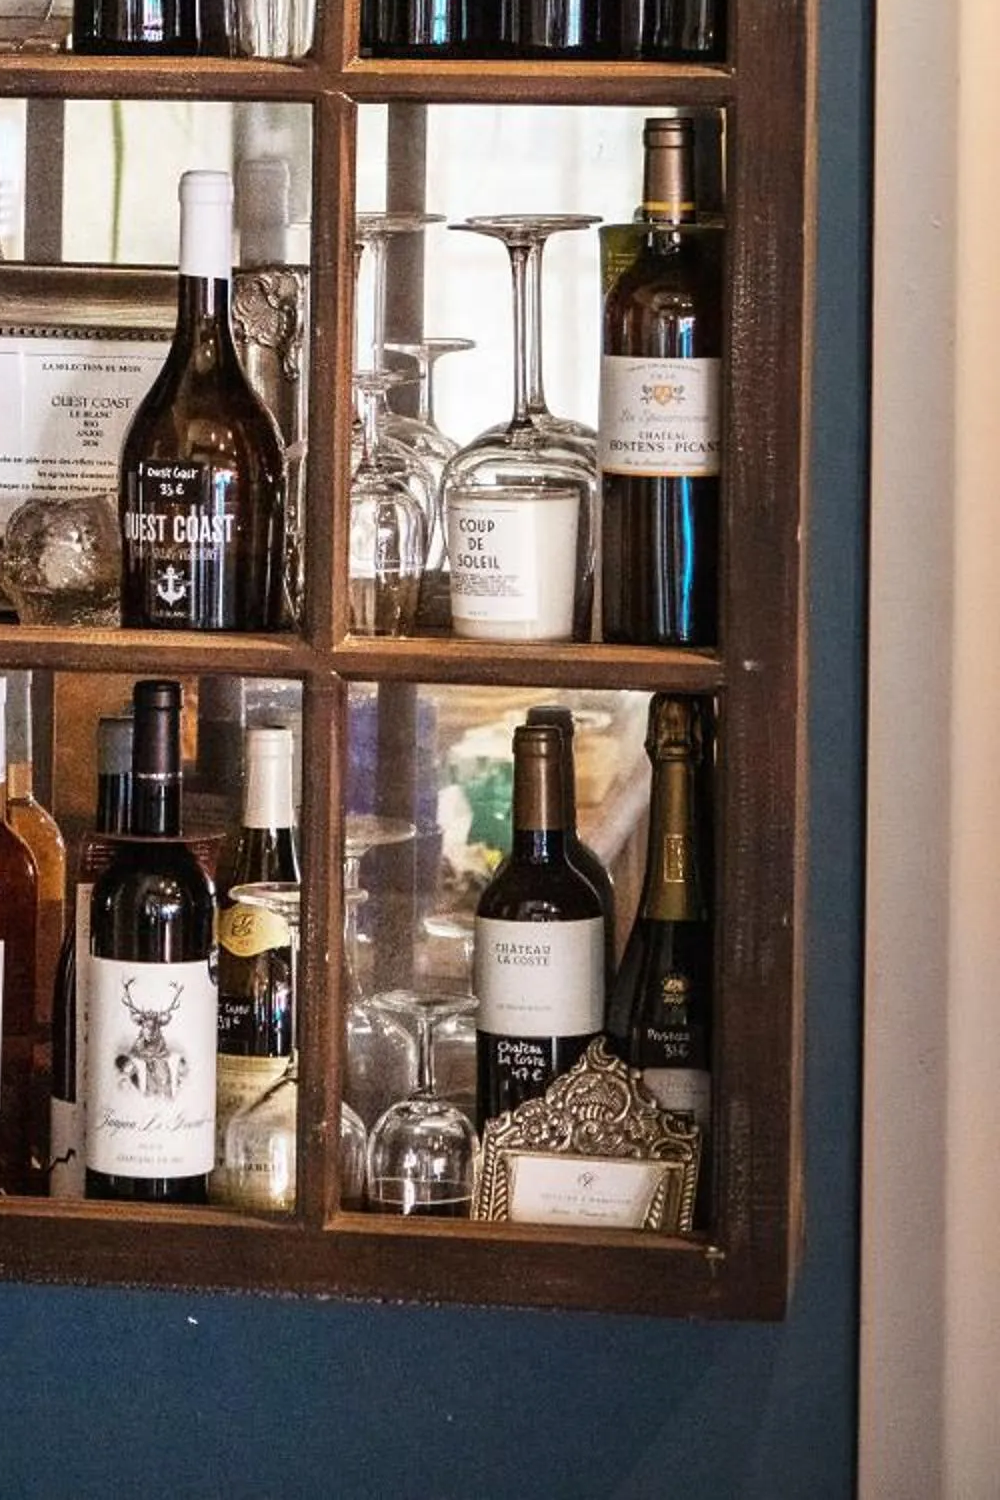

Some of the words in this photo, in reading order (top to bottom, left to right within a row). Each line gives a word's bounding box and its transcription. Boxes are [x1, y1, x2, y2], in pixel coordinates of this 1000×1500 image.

[125, 512, 167, 543] OUEST
[173, 513, 236, 544] COAST
[459, 518, 495, 533] COUP
[467, 537, 485, 551] DE
[457, 554, 500, 569] SOLEIL
